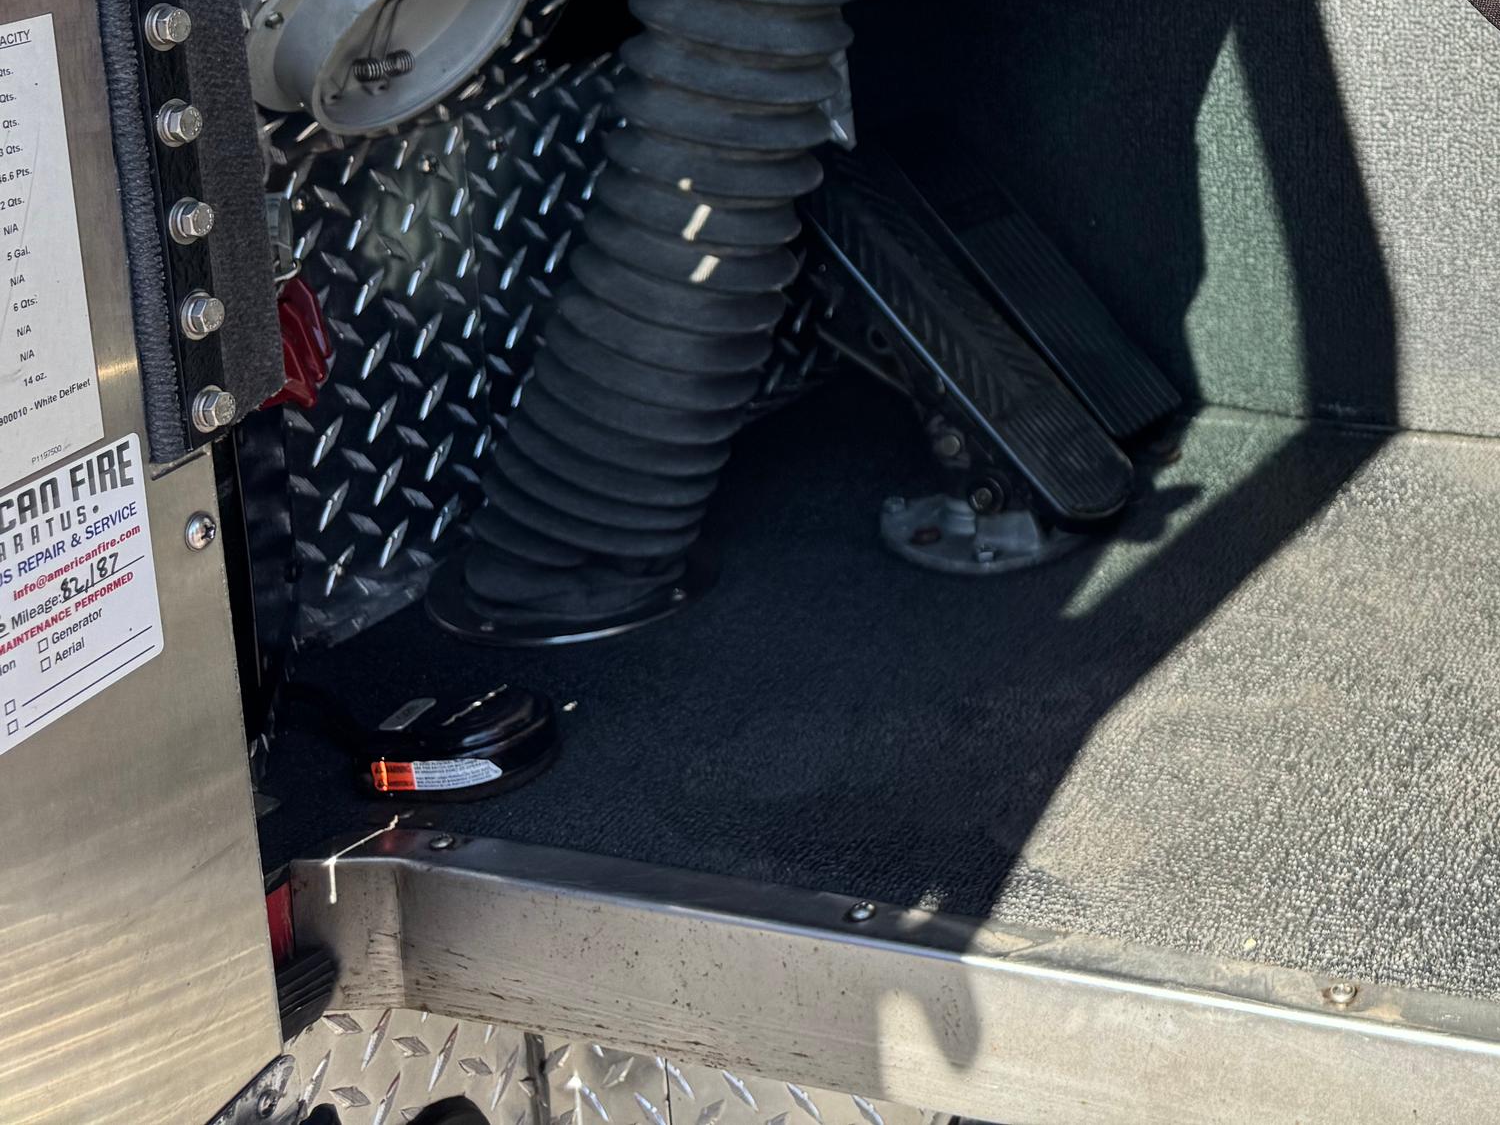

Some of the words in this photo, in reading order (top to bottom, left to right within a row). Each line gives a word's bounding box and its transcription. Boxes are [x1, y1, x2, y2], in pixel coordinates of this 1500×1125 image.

[3, 119, 20, 129] Qts.
[6, 144, 23, 155] Qts.
[16, 168, 32, 178] Pts.
[8, 197, 25, 208] Qts.
[3, 223, 19, 235] N/A
[14, 245, 31, 258] Gal.
[10, 274, 25, 287] N/A
[13, 302, 19, 312] 6
[16, 324, 32, 337] N/A
[19, 349, 35, 362] N/A
[23, 375, 33, 387] 14
[35, 372, 48, 382] oz.
[34, 393, 58, 411] White
[59, 378, 91, 400] DelFleet
[69, 440, 134, 502] FIRE
[17, 540, 66, 577] REPAIR
[70, 533, 82, 548] &
[85, 501, 138, 540] SERVICE
[13, 525, 141, 601] info@americanfire.com
[74, 571, 134, 612] PERFORMED
[11, 593, 62, 630] Mileage:
[51, 607, 103, 644] Generator
[55, 636, 85, 664] Aerial
